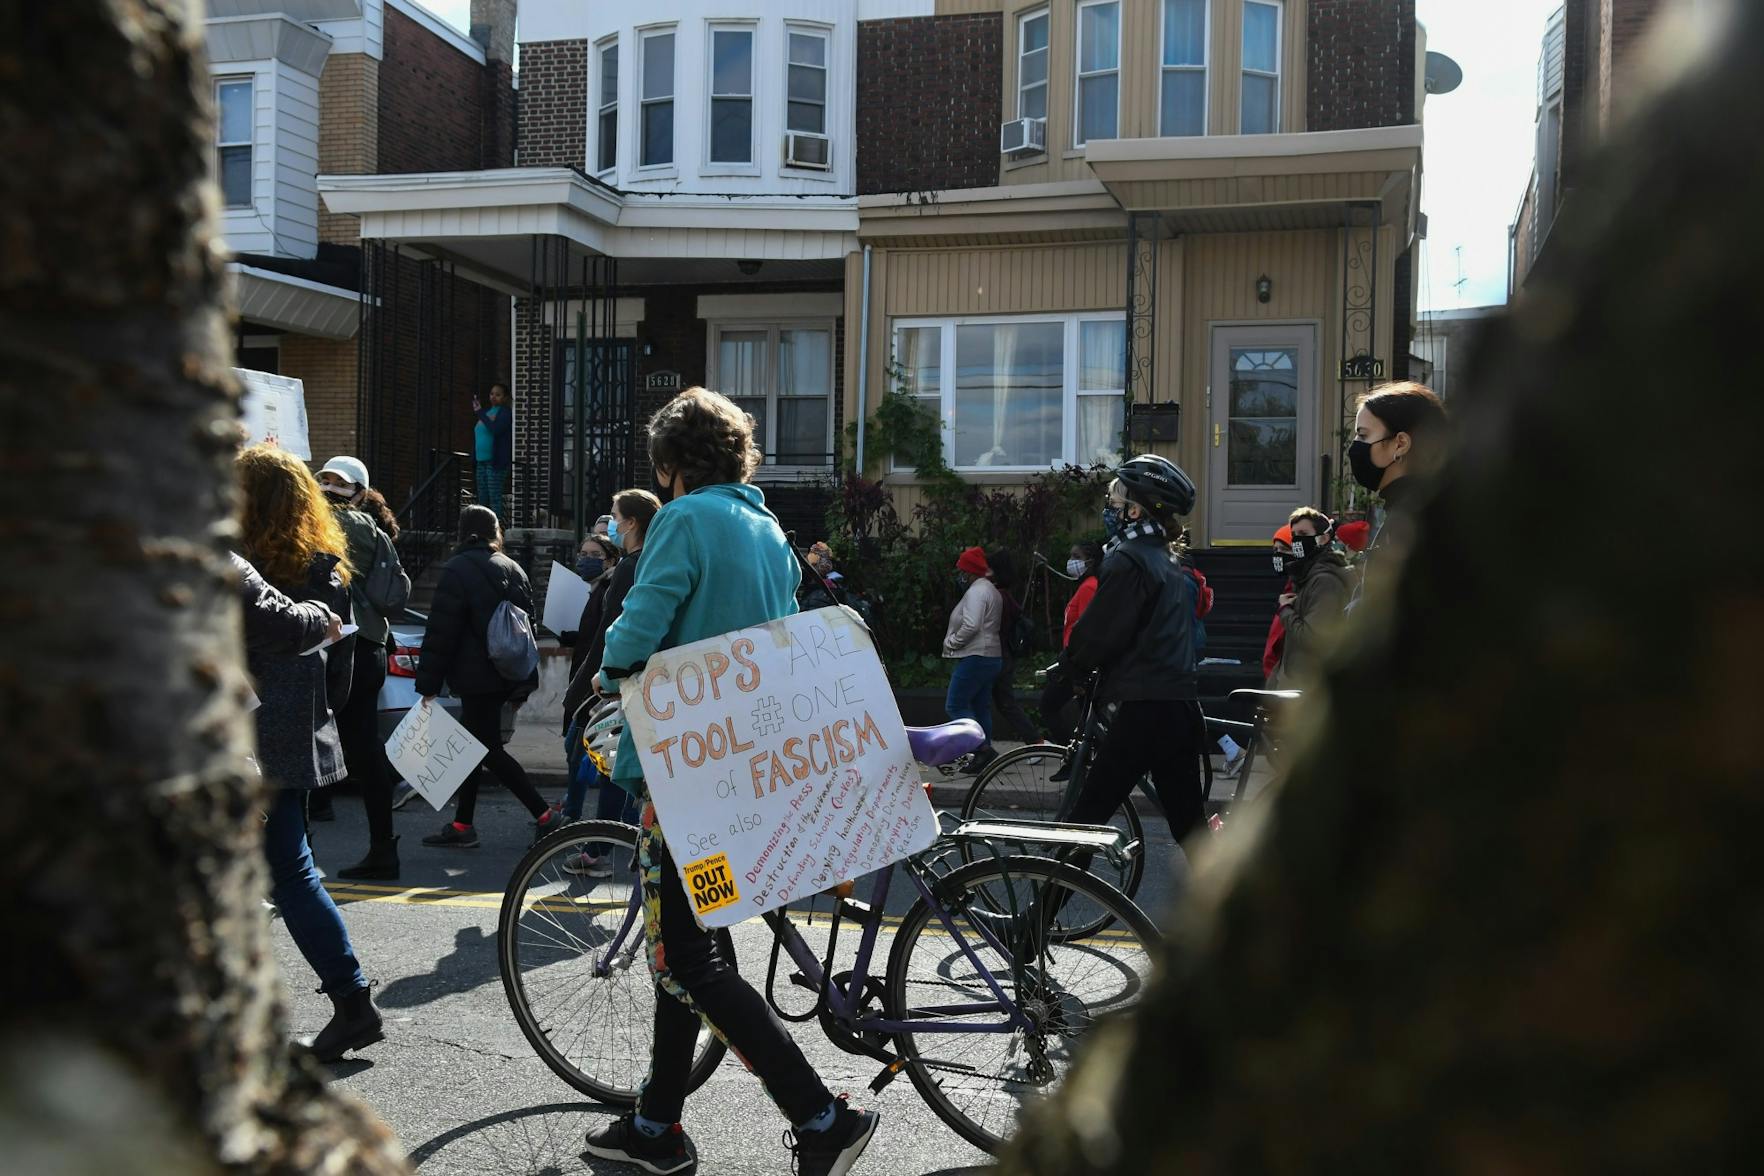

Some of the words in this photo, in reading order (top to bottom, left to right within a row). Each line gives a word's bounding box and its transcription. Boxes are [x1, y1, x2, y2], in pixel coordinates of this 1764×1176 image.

[642, 638, 760, 721] COPS
[790, 624, 862, 676] ARE
[393, 705, 433, 760] SHOULD
[413, 730, 438, 758] BE
[650, 716, 754, 778] TOOL
[716, 769, 737, 799] of
[750, 710, 888, 799] FASCISM
[417, 728, 472, 793] ALIVE!
[686, 833, 720, 857] See
[729, 812, 762, 836] also
[745, 822, 791, 884] Demonizing
[790, 782, 813, 811] Press
[809, 813, 835, 850] Schools
[692, 865, 726, 890] OUT
[752, 836, 798, 907] Destruction
[801, 812, 812, 825] the
[811, 844, 841, 889] Denying
[694, 879, 735, 909] NOW
